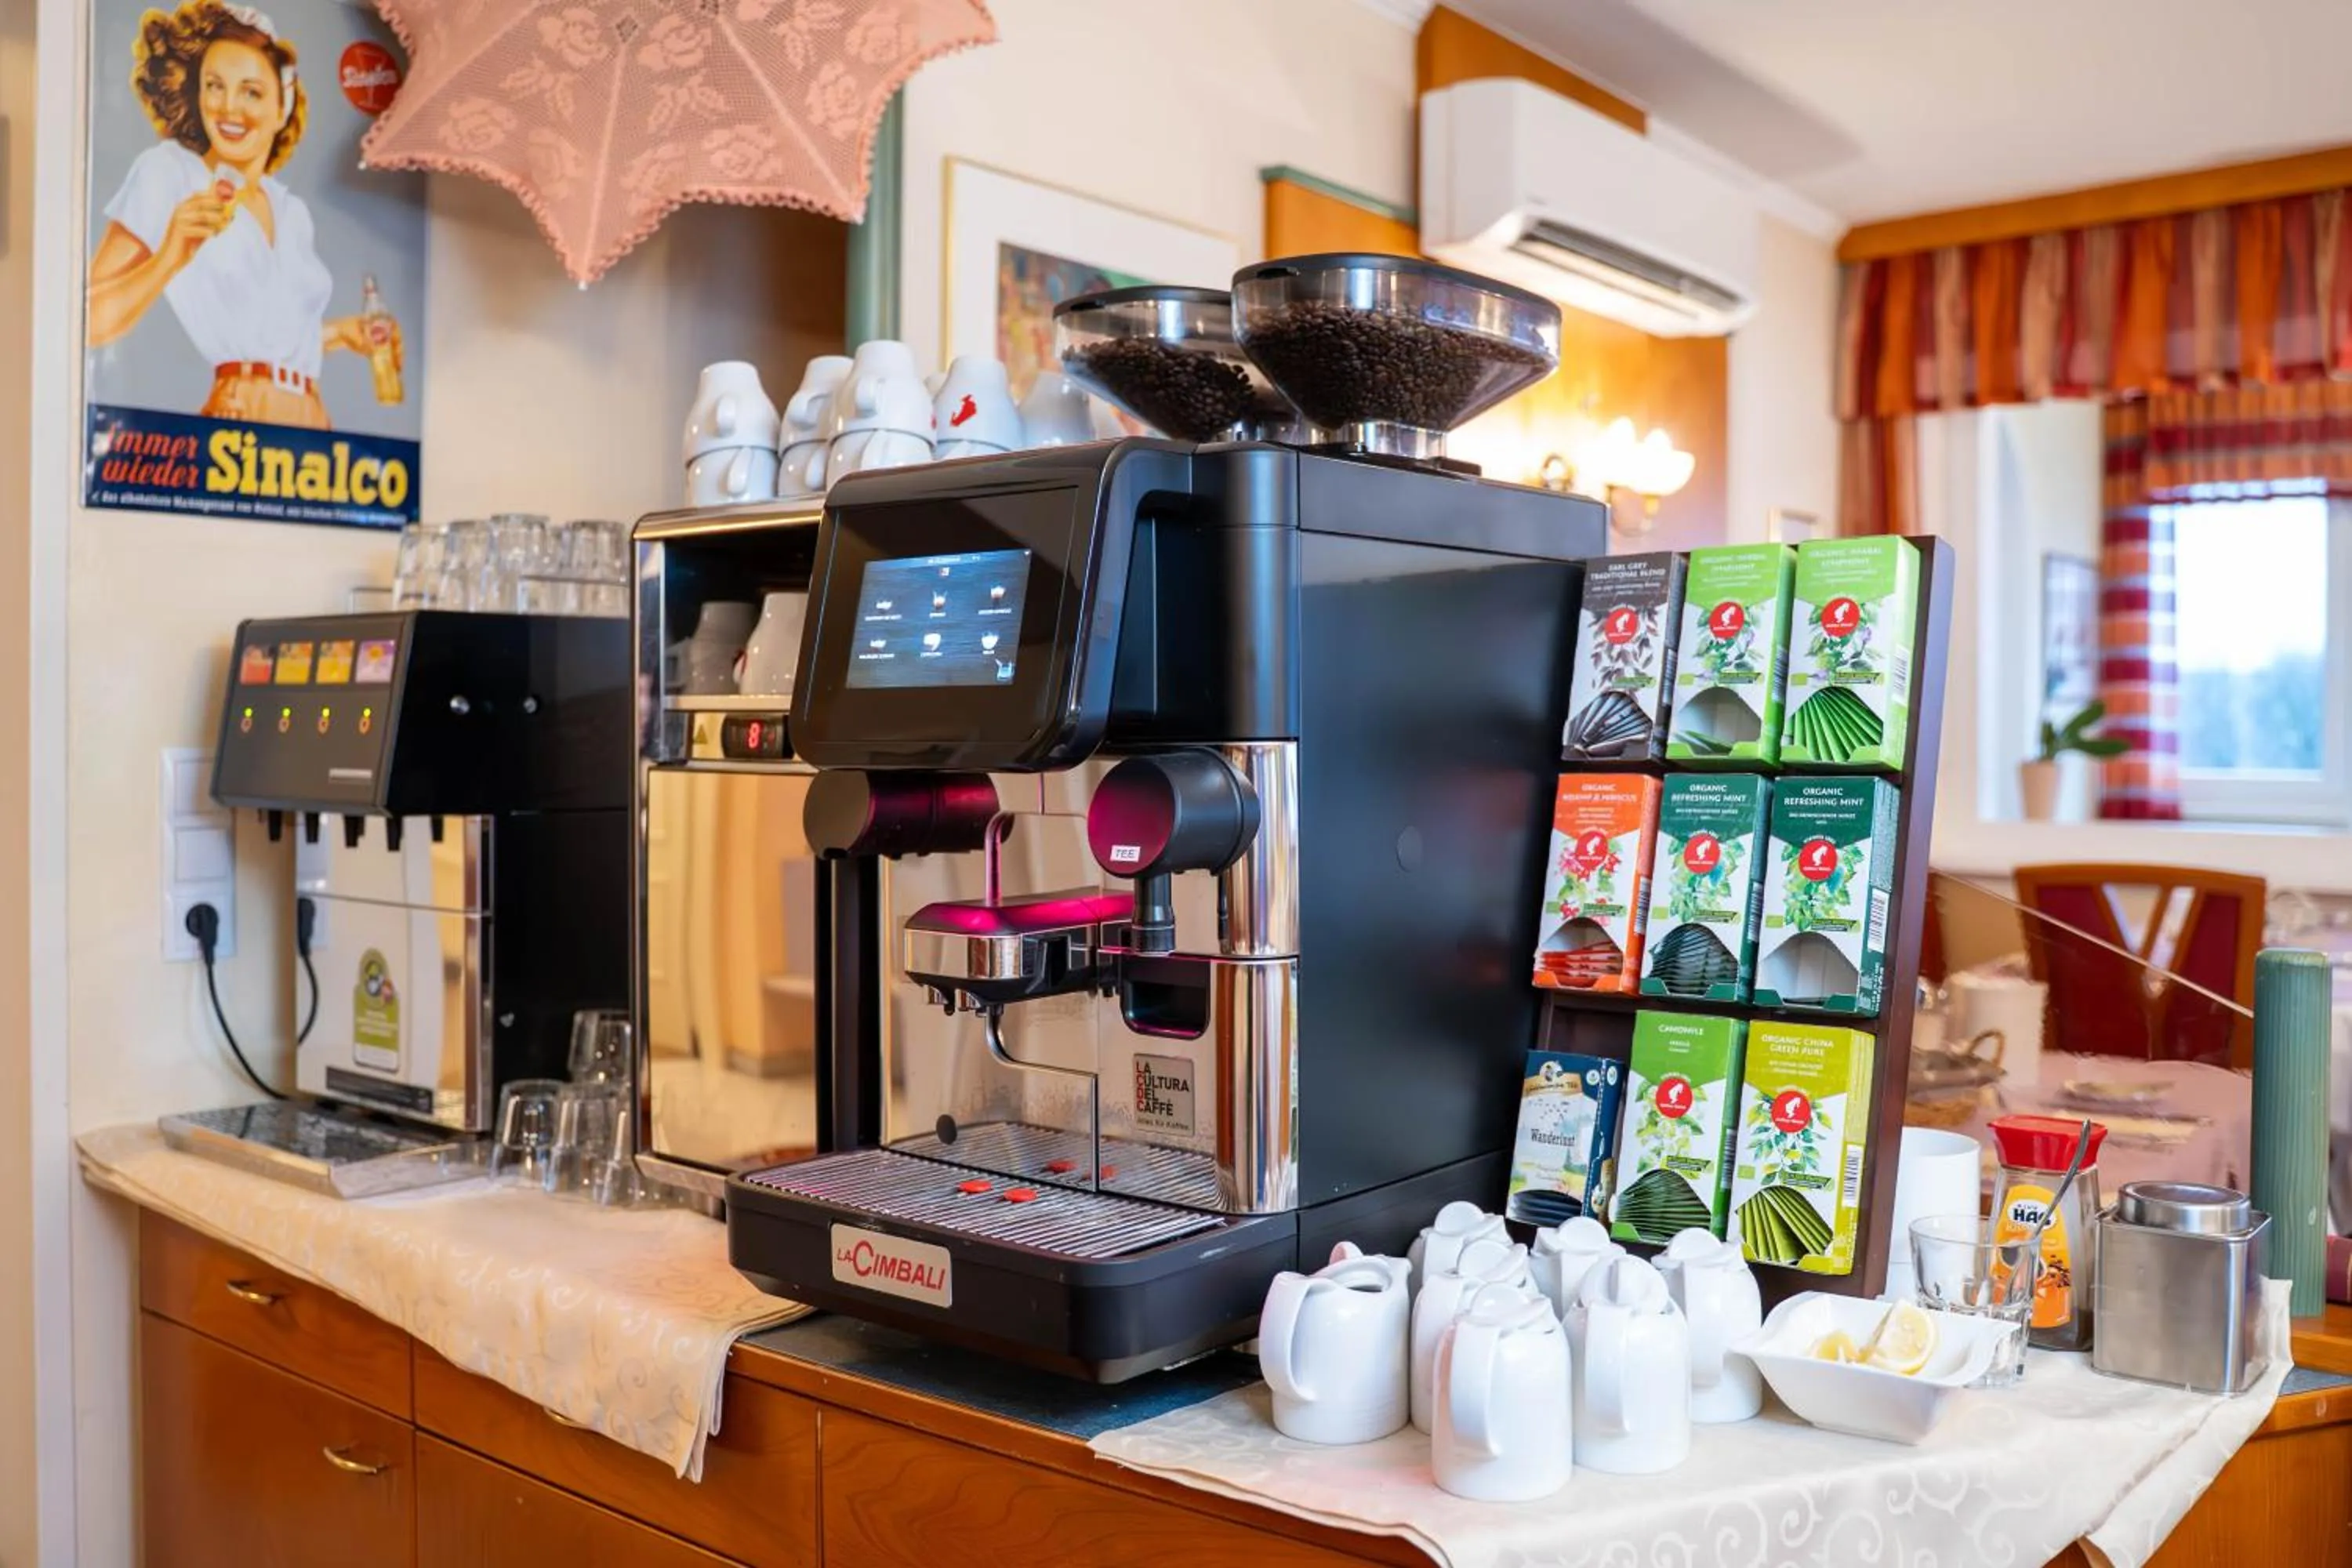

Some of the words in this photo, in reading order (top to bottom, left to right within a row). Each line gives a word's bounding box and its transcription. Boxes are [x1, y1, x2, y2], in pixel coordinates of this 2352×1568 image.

[101, 454, 198, 490] wieder
[206, 428, 408, 508] Sinalco
[1590, 572, 1638, 581] TRADITIONAL
[1639, 568, 1666, 577] BLEND
[1690, 783, 1728, 793] ORGANIC
[1802, 787, 1844, 796] ORGANIC
[1671, 793, 1721, 802] REFRESHING
[1784, 797, 1838, 807] REFRESHING
[1839, 797, 1865, 807] MINT
[1116, 849, 1135, 858] TEE
[1761, 1033, 1802, 1045] ORGANIC
[1769, 1043, 1799, 1054] GREEN
[1136, 1061, 1152, 1074] LA
[1136, 1073, 1190, 1092] CULTURA
[1136, 1087, 1159, 1102] DEL
[1531, 1128, 1576, 1147] Wanderlust
[852, 1240, 946, 1290] CIMBALI
